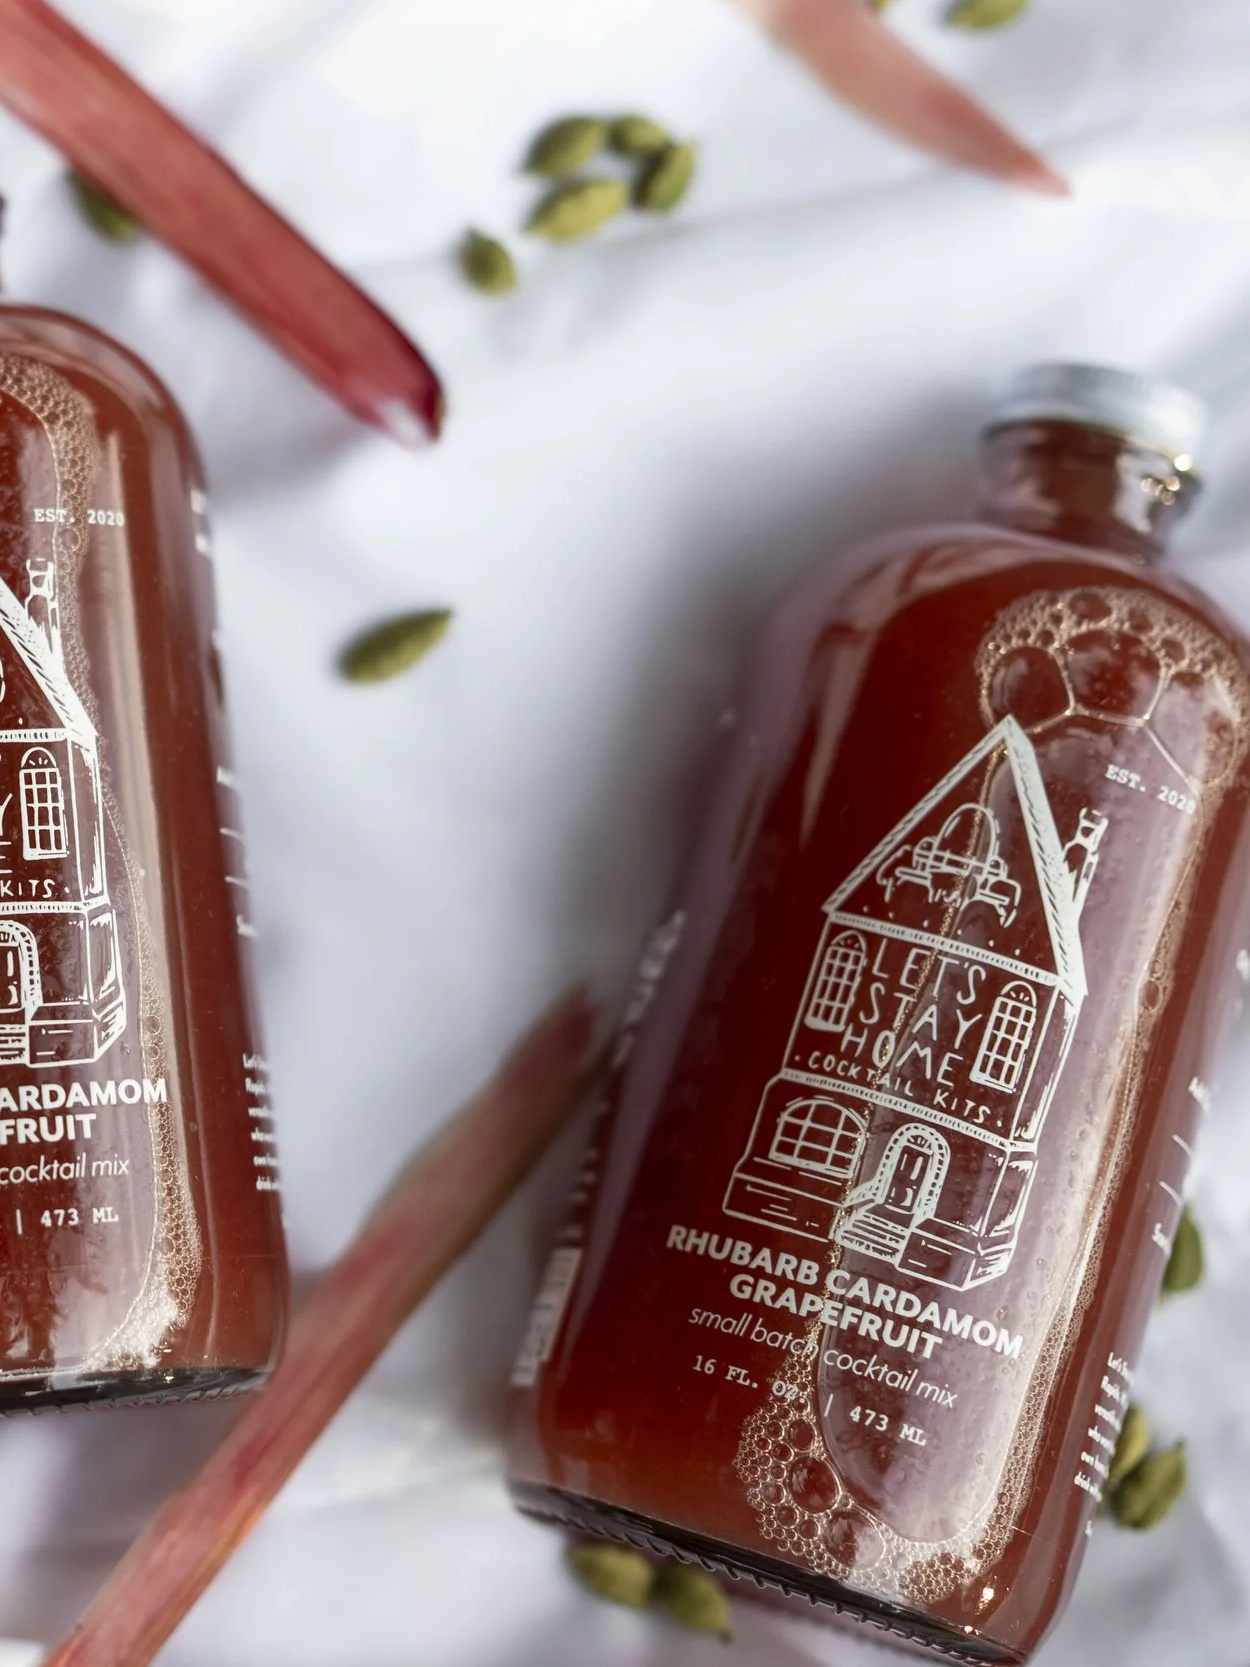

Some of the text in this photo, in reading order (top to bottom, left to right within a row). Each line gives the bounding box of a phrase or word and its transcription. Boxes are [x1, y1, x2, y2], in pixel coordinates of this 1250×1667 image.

[33, 508, 125, 527] EST. 2020
[1104, 763, 1196, 815] EST. 2020
[0, 879, 55, 898] KITS
[872, 938, 986, 1005] LET'S
[859, 982, 983, 1049] STAY
[808, 1051, 991, 1124] COCKTAIL KITS
[840, 1022, 964, 1087] HOME
[91, 1154, 129, 1177] mix
[40, 1208, 79, 1228] 473
[92, 1205, 118, 1223] ML
[666, 1224, 1024, 1360] RHUBARB CARDAMOM
[730, 1273, 943, 1359] GRAPEFRUIT
[688, 1307, 958, 1408] small batch cocktail mix
[692, 1355, 716, 1375] 16
[724, 1365, 759, 1389] FL.
[772, 1379, 806, 1404] OZ.
[849, 1405, 888, 1432] 473
[900, 1423, 927, 1446] ML
